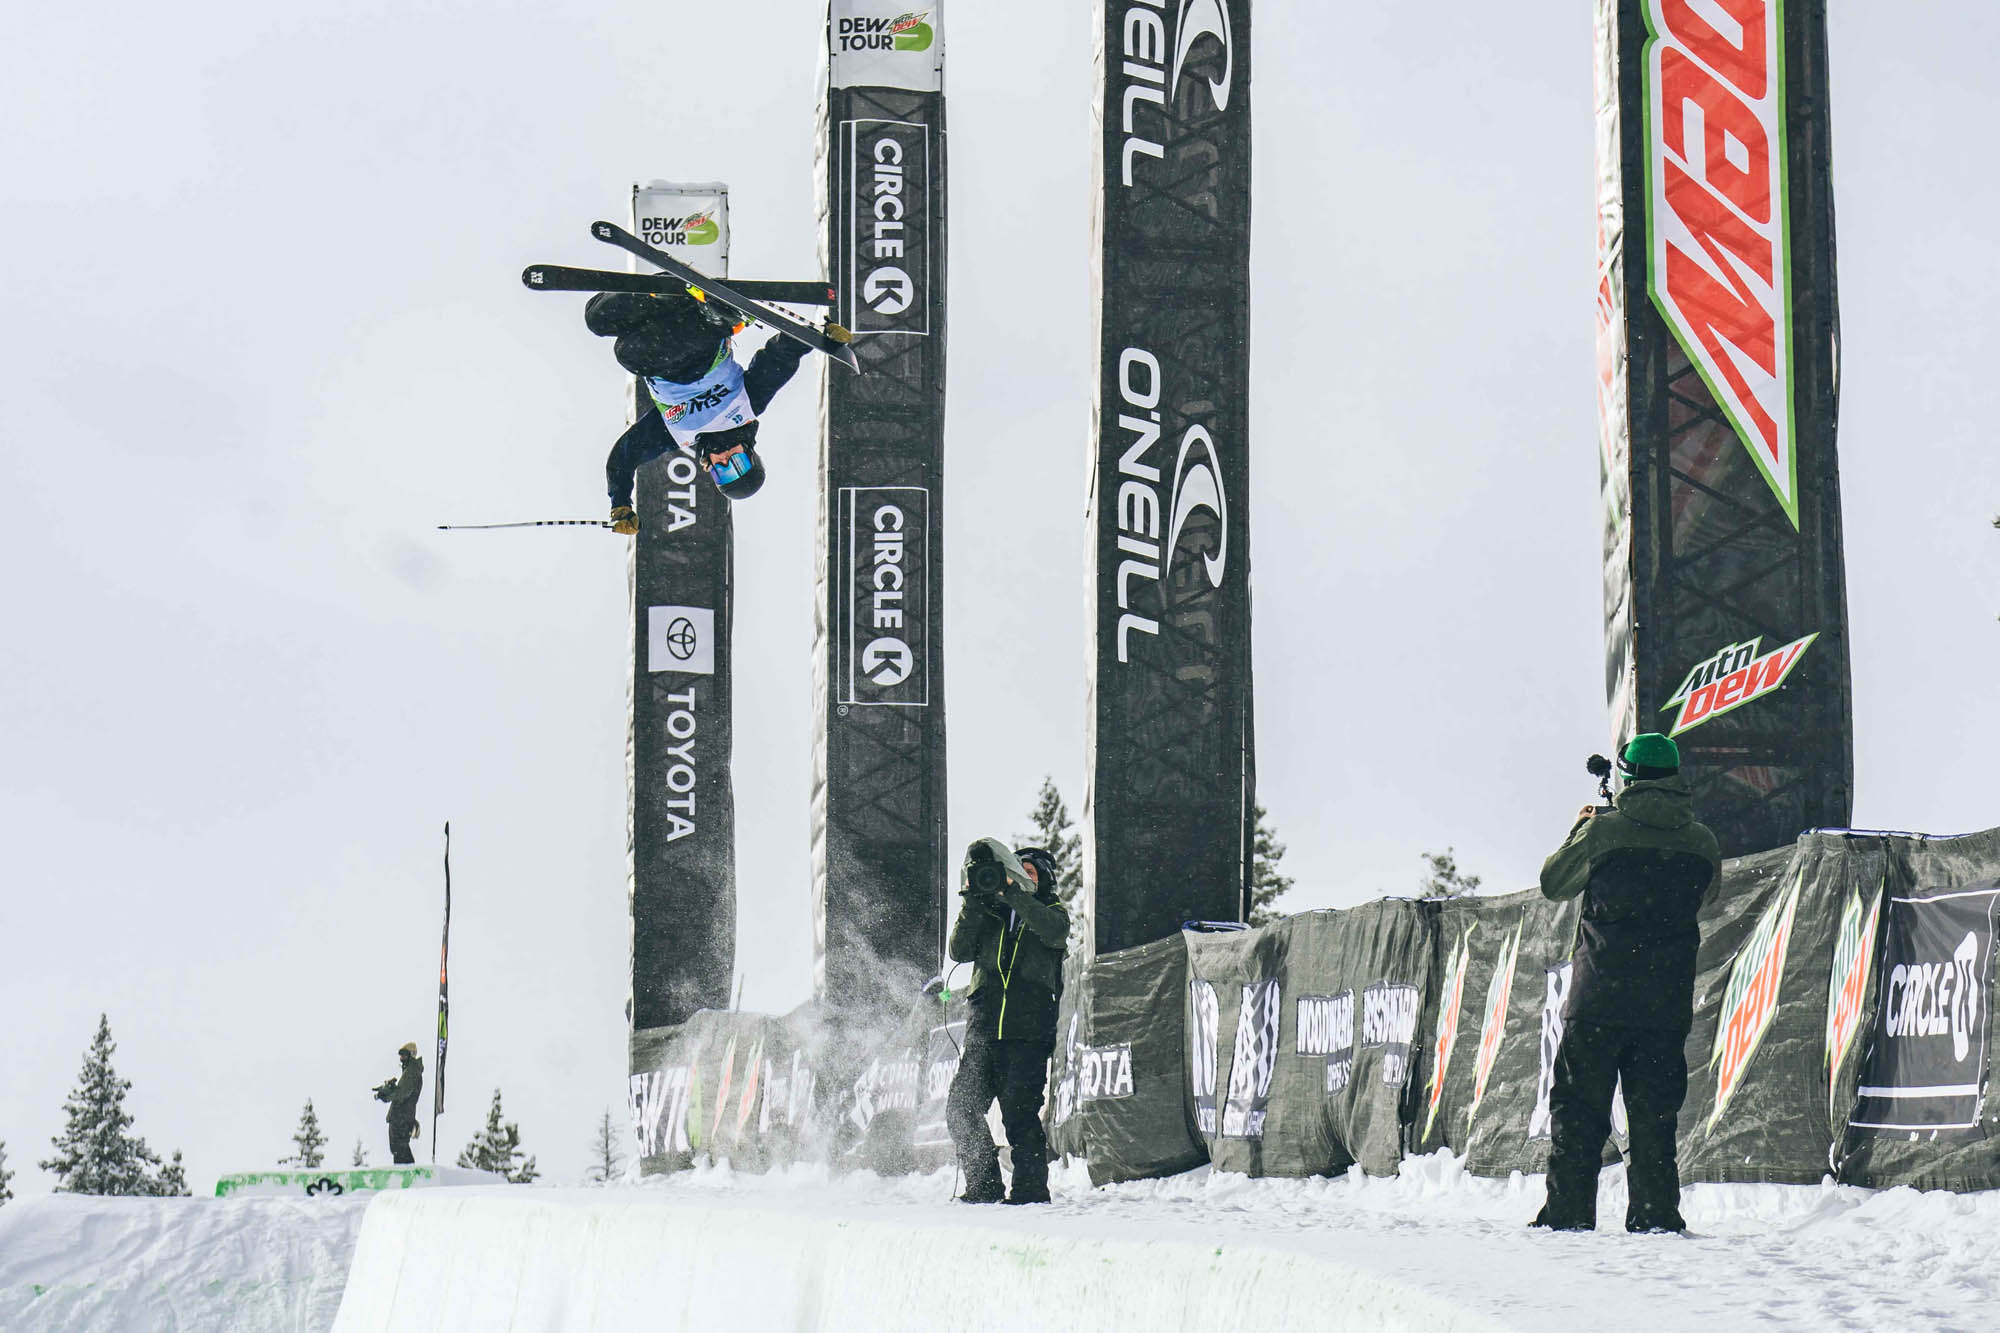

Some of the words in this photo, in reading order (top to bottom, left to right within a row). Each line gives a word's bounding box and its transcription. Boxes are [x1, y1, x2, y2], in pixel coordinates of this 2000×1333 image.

[839, 17, 890, 34] DEW
[839, 34, 893, 51] TOUR
[1122, 0, 1165, 187] EILL
[642, 217, 683, 231] DEW
[642, 231, 686, 245] TOUR
[873, 137, 903, 258] CIRCLE
[1117, 347, 1161, 663] O'NEILL
[873, 505, 904, 629] CIRCLE
[667, 688, 696, 842] TOYOTA
[1886, 962, 1954, 1038] CIRCLE
